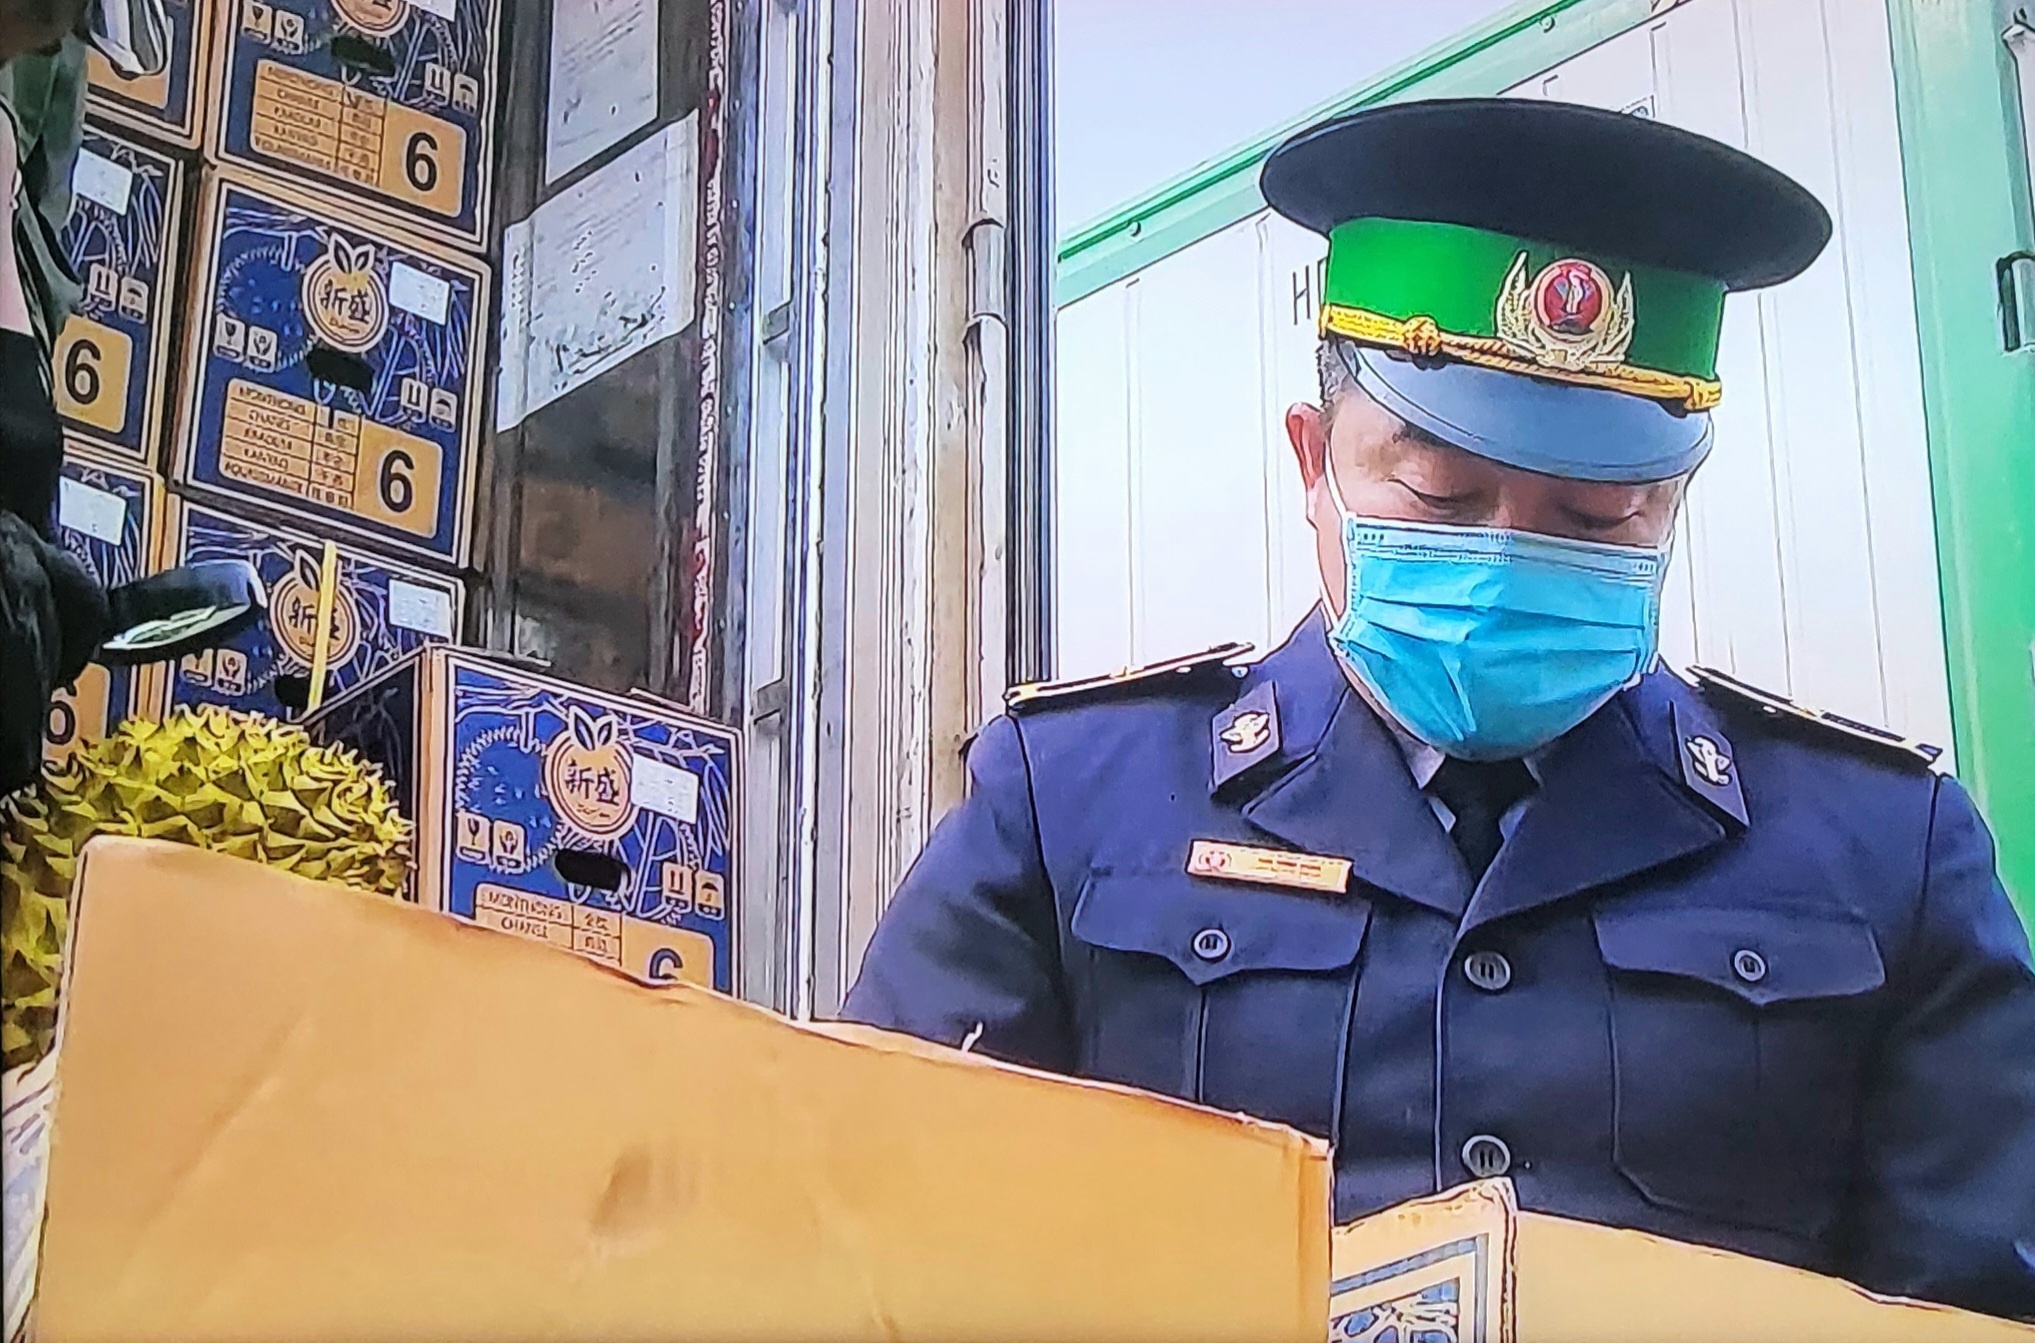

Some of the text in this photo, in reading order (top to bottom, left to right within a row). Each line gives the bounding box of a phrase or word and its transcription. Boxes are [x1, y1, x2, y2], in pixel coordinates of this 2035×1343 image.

[405, 132, 439, 192] 6
[64, 338, 102, 406] 6
[380, 449, 415, 513] 6
[563, 755, 621, 807] 新盛
